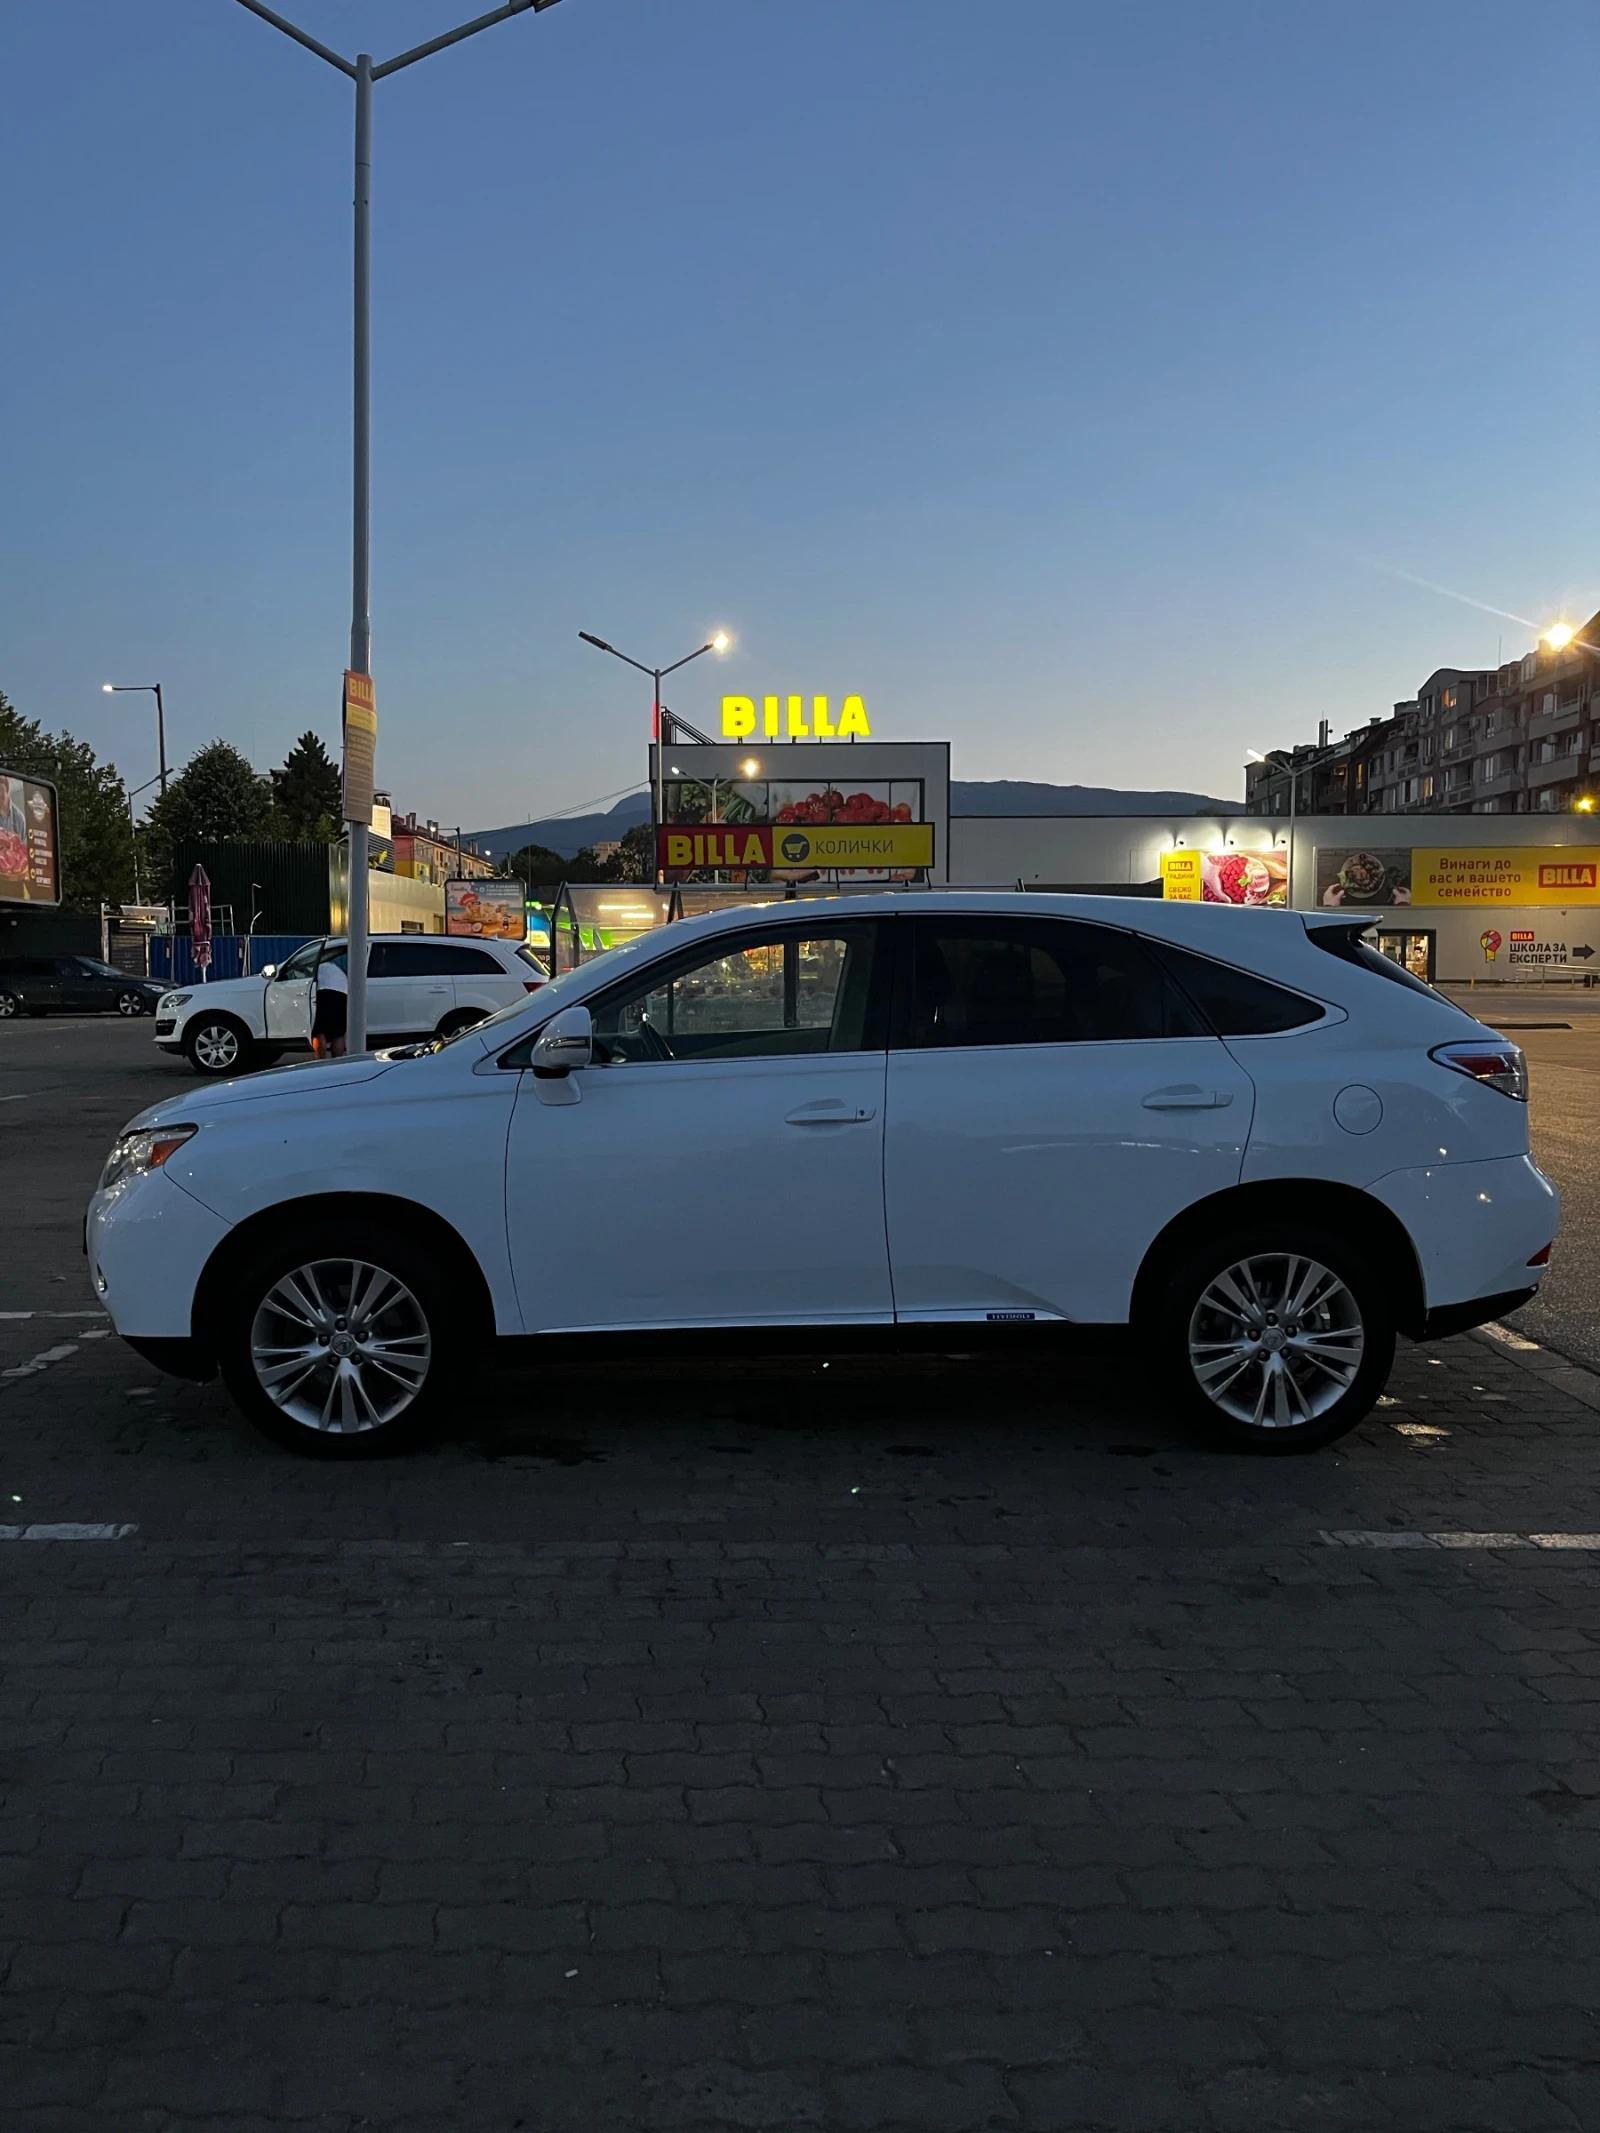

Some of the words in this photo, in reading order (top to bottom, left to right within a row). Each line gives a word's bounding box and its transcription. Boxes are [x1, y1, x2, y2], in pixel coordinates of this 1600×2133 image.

[721, 694, 871, 737] BILLA
[667, 833, 766, 866] BILLA
[815, 839, 894, 855] КОЛИЧКИ
[1169, 862, 1192, 870] BILLA
[1439, 858, 1491, 870] Винаги
[1494, 859, 1512, 871] до
[1429, 873, 1452, 884] вас
[1456, 874, 1465, 883] и
[1469, 872, 1521, 884] вашето
[1542, 867, 1593, 885] BILLA
[1437, 885, 1512, 897] семейство
[1511, 932, 1533, 940] BILLA
[1509, 943, 1551, 953] ШКОЛА
[1552, 942, 1567, 953] ЗА
[1508, 953, 1568, 964] ЕКСПЕРТИ
